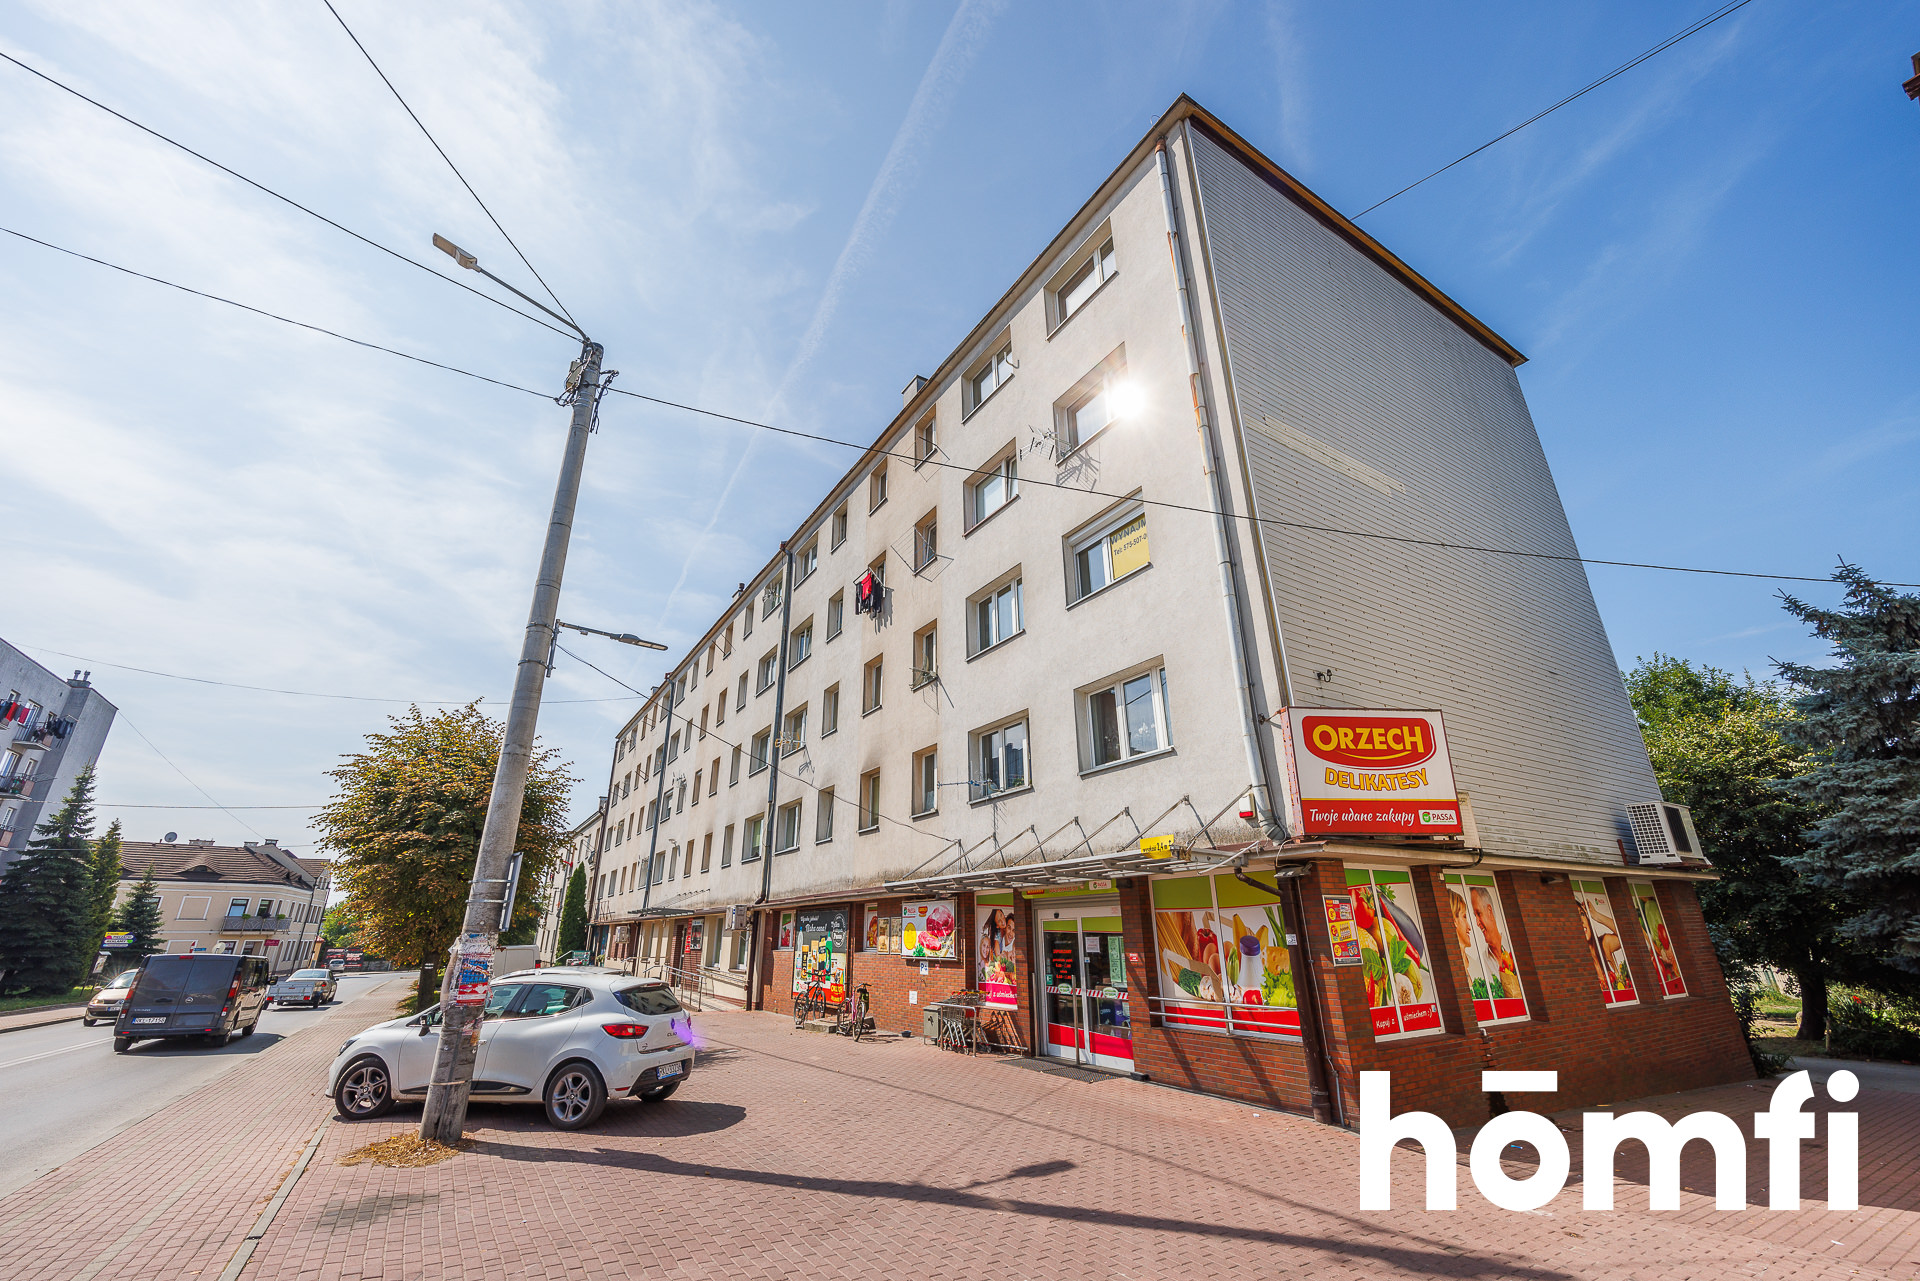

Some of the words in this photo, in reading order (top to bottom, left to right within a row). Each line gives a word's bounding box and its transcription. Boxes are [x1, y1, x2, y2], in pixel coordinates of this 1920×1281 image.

[1312, 724, 1425, 753] ORZECH
[1325, 767, 1429, 791] DELIKATESY
[1309, 808, 1339, 826] Twoje
[1341, 807, 1373, 823] udane
[1375, 808, 1415, 826] zakupy
[1432, 813, 1454, 821] PASSA
